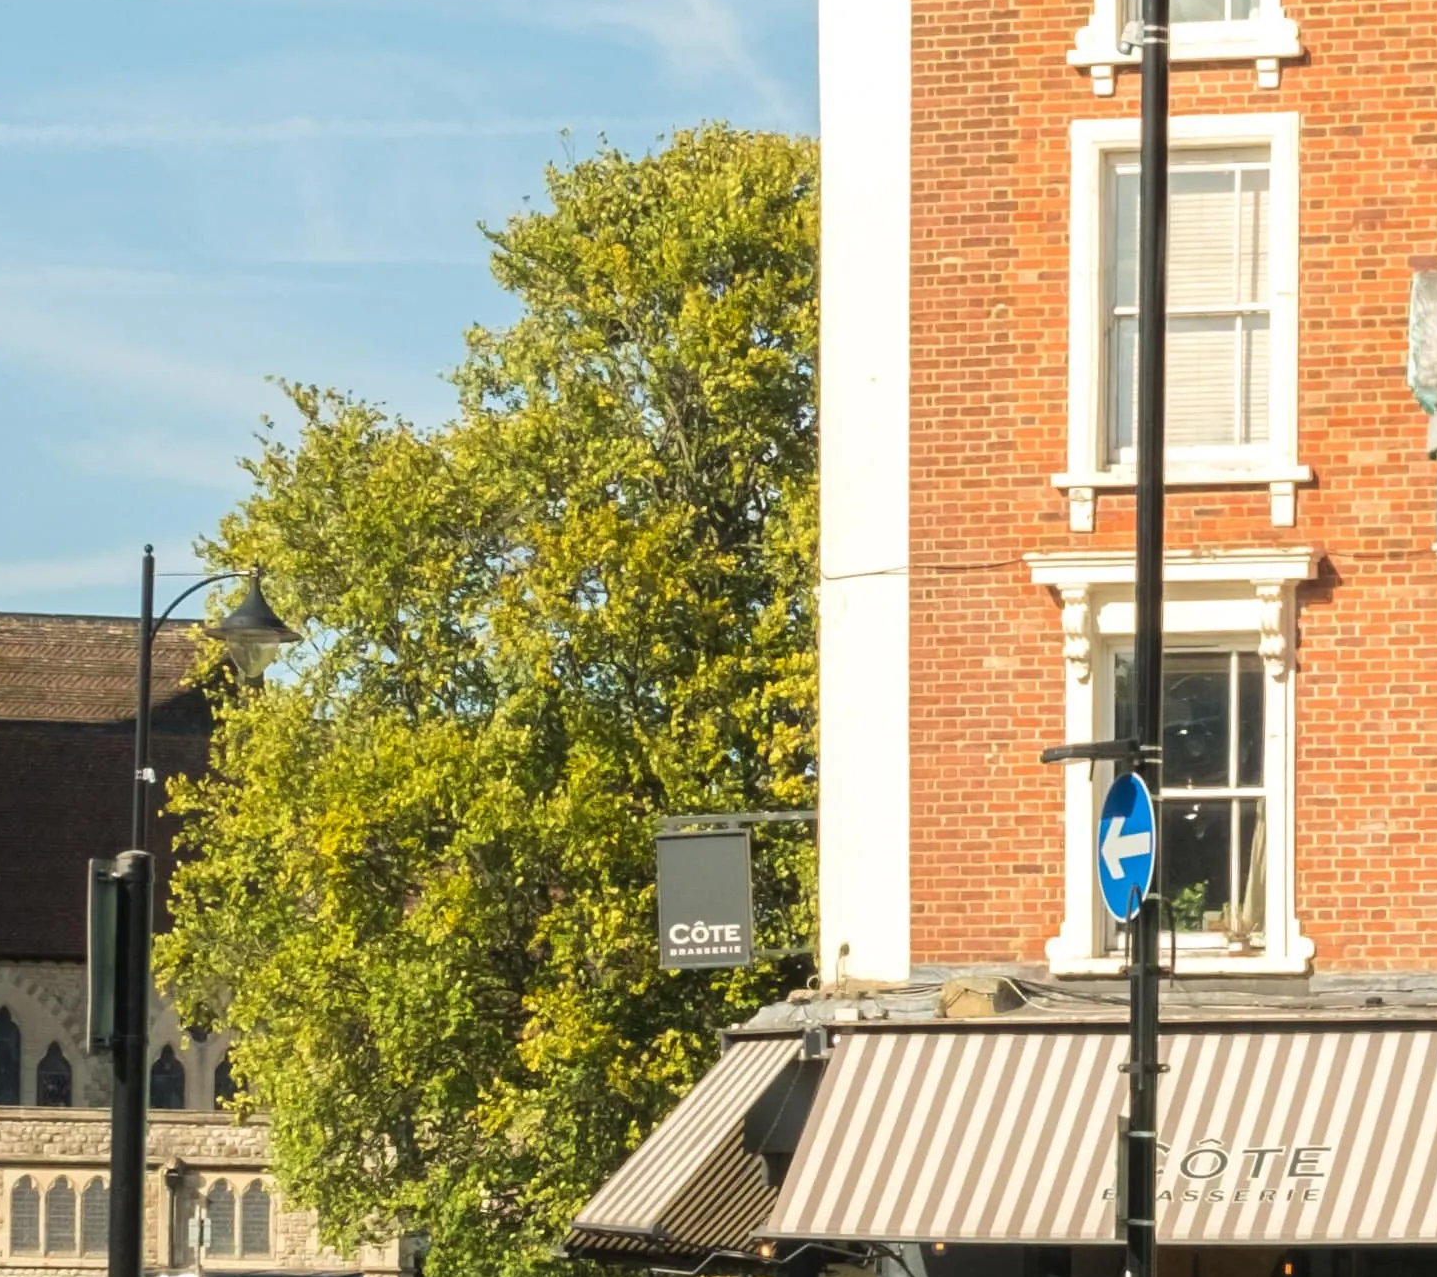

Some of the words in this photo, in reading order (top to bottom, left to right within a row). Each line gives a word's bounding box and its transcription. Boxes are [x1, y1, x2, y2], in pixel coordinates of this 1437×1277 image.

[669, 921, 741, 944] CÔTE
[670, 946, 742, 956] BRASSERIE
[1156, 1138, 1332, 1178] ÔTE
[1102, 1188, 1322, 1203] BASSERIE
